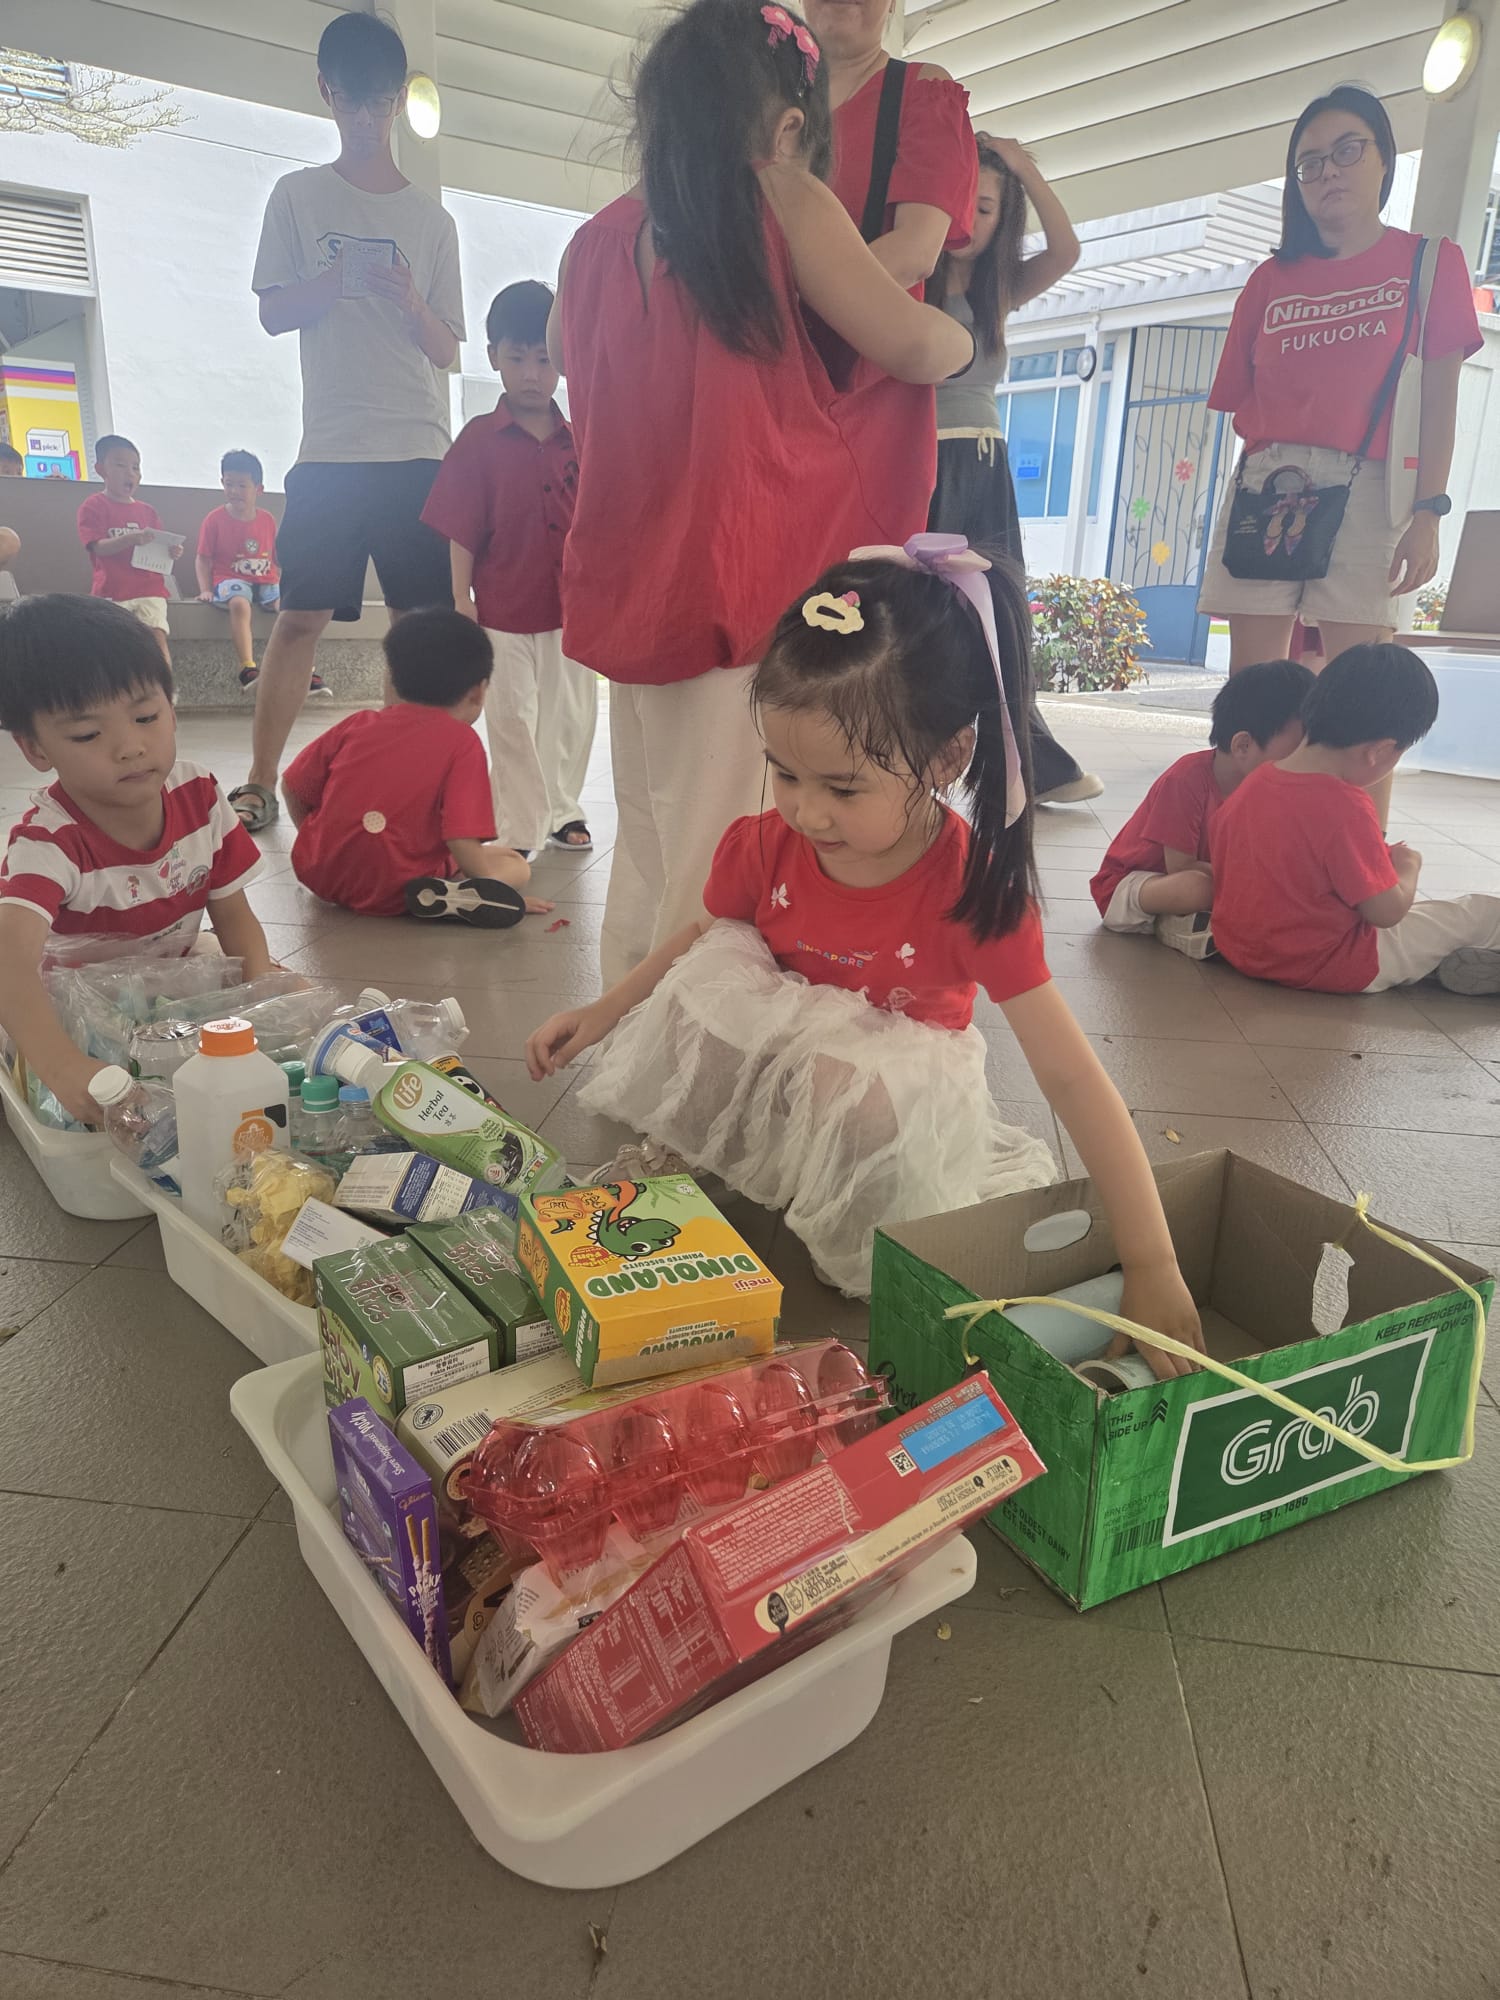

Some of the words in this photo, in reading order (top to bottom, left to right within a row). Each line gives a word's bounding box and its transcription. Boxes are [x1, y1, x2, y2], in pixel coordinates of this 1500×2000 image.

[1272, 287, 1403, 324] Nintendo
[1281, 320, 1387, 354] FUKUOKA
[796, 939, 864, 969] SINGAPORE
[418, 1090, 445, 1121] Herbal
[433, 1105, 449, 1121] Tea
[443, 1244, 494, 1286] Bites
[622, 1257, 663, 1270] BISCUITS
[664, 1252, 704, 1265] PRINTED
[587, 1254, 759, 1297] DINOLAND
[735, 1277, 772, 1291] meiji
[345, 1279, 391, 1324] Bites
[1375, 1323, 1406, 1341] KEEP
[418, 1357, 442, 1369] Nutrition
[443, 1346, 475, 1360] Information
[1110, 1412, 1134, 1425] THIS
[1108, 1426, 1131, 1439] SIDE
[1132, 1421, 1149, 1431] UP
[1221, 1375, 1379, 1485] Grab
[983, 1462, 1003, 1477] MILK
[938, 1495, 958, 1511] FRUIT
[1001, 1503, 1022, 1522] EST.
[1018, 1506, 1047, 1530] OLDEST
[1044, 1531, 1071, 1561] DAIRY
[799, 1571, 824, 1591] SIZE?
[804, 1573, 841, 1600] PORTION
